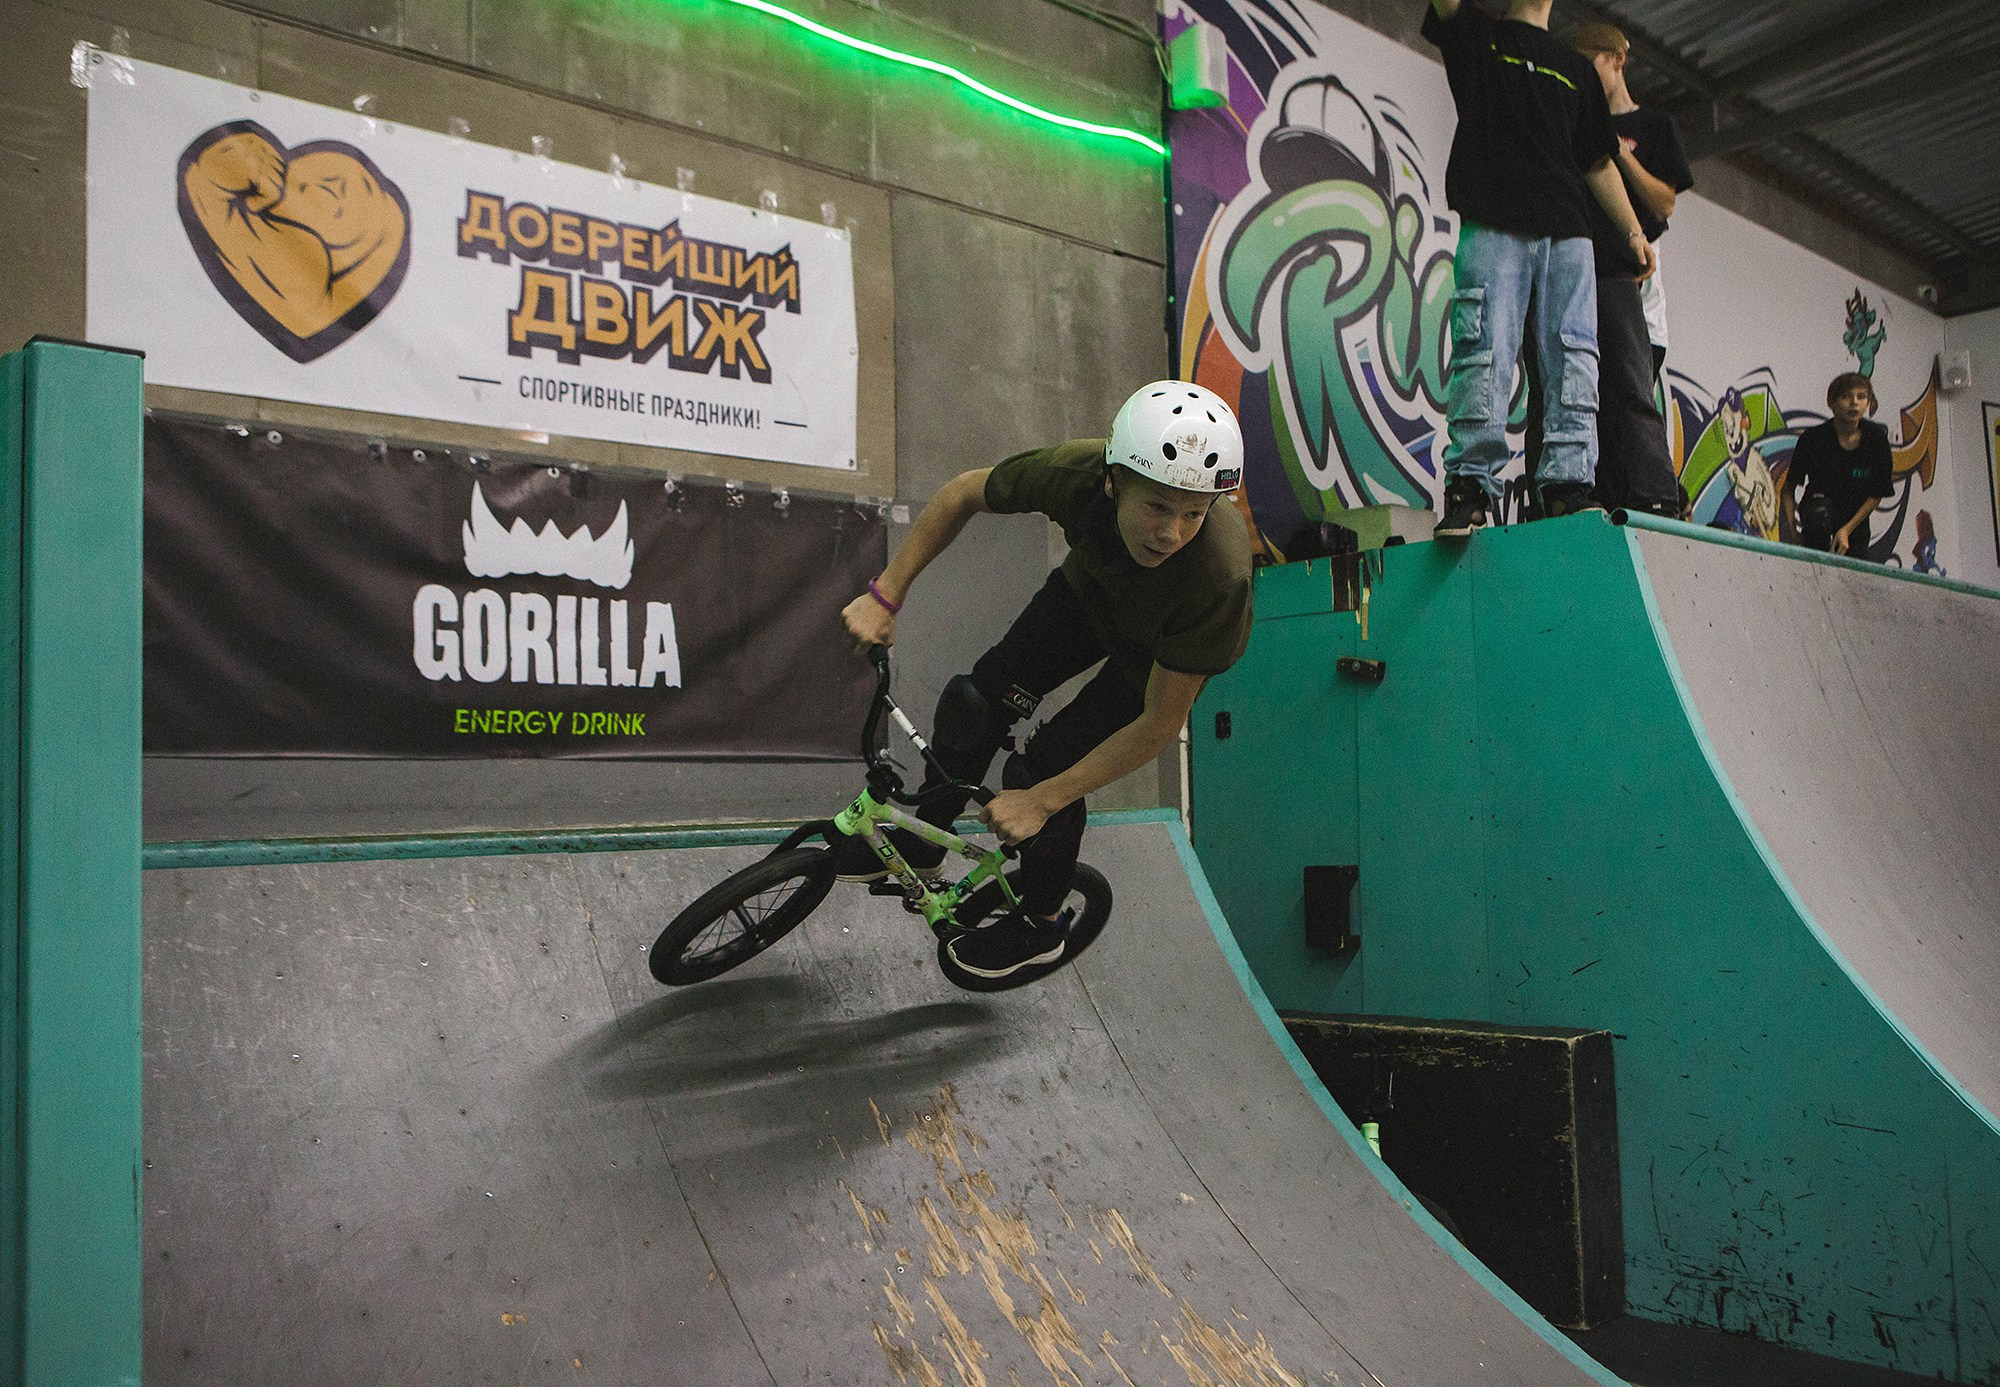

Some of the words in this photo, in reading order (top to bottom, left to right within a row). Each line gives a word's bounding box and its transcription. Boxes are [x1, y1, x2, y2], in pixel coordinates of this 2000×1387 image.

[457, 190, 802, 313] ДОБРЕЙШИЙ
[508, 264, 772, 384] ДВИЖ
[519, 375, 646, 415] СПОРТИВНЫЕ
[651, 390, 762, 430] ПРАЗДНИКИ!
[413, 584, 682, 688] GORILLA
[453, 709, 563, 735] ENERGY
[571, 712, 646, 736] DRINK
